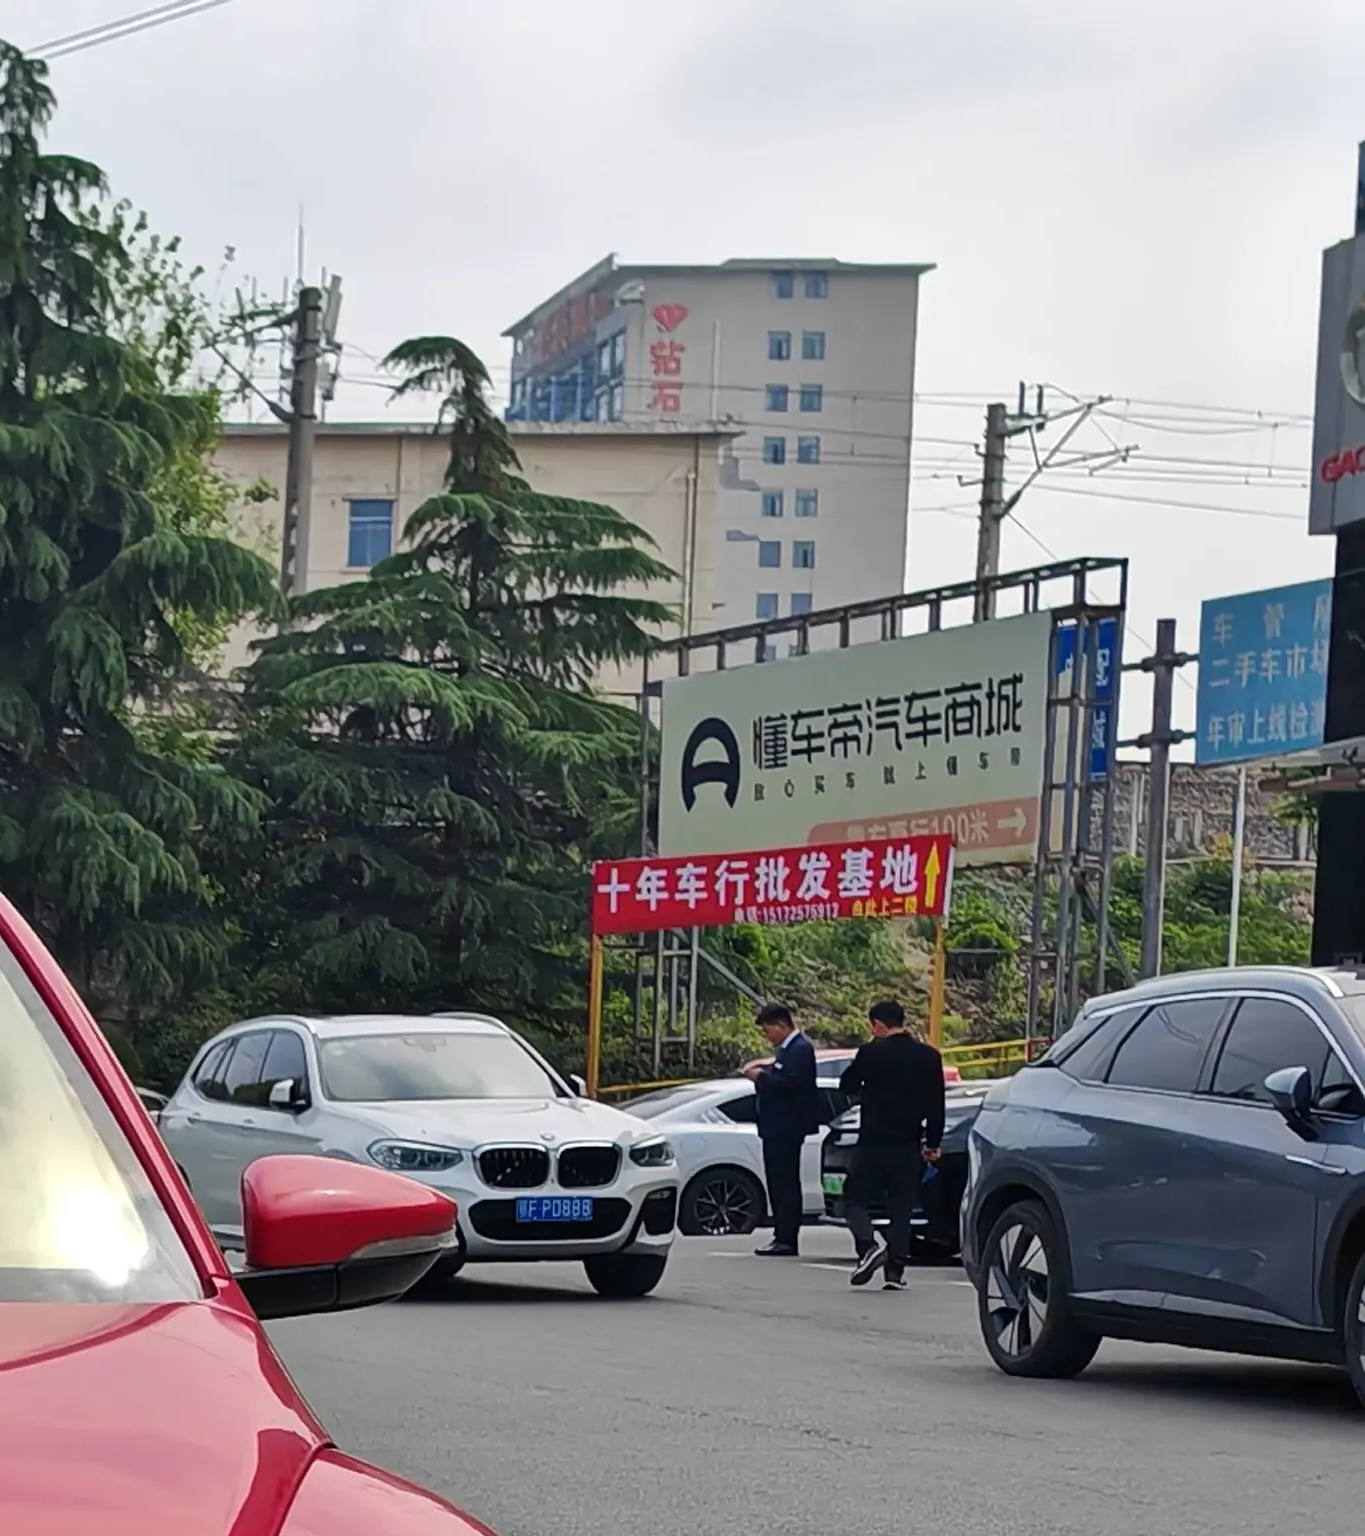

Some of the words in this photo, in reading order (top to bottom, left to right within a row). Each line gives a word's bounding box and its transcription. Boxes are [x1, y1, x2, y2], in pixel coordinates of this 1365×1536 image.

[753, 673, 1023, 771] 懂车帝汽车商城
[597, 844, 919, 914] 十年车行批发基地
